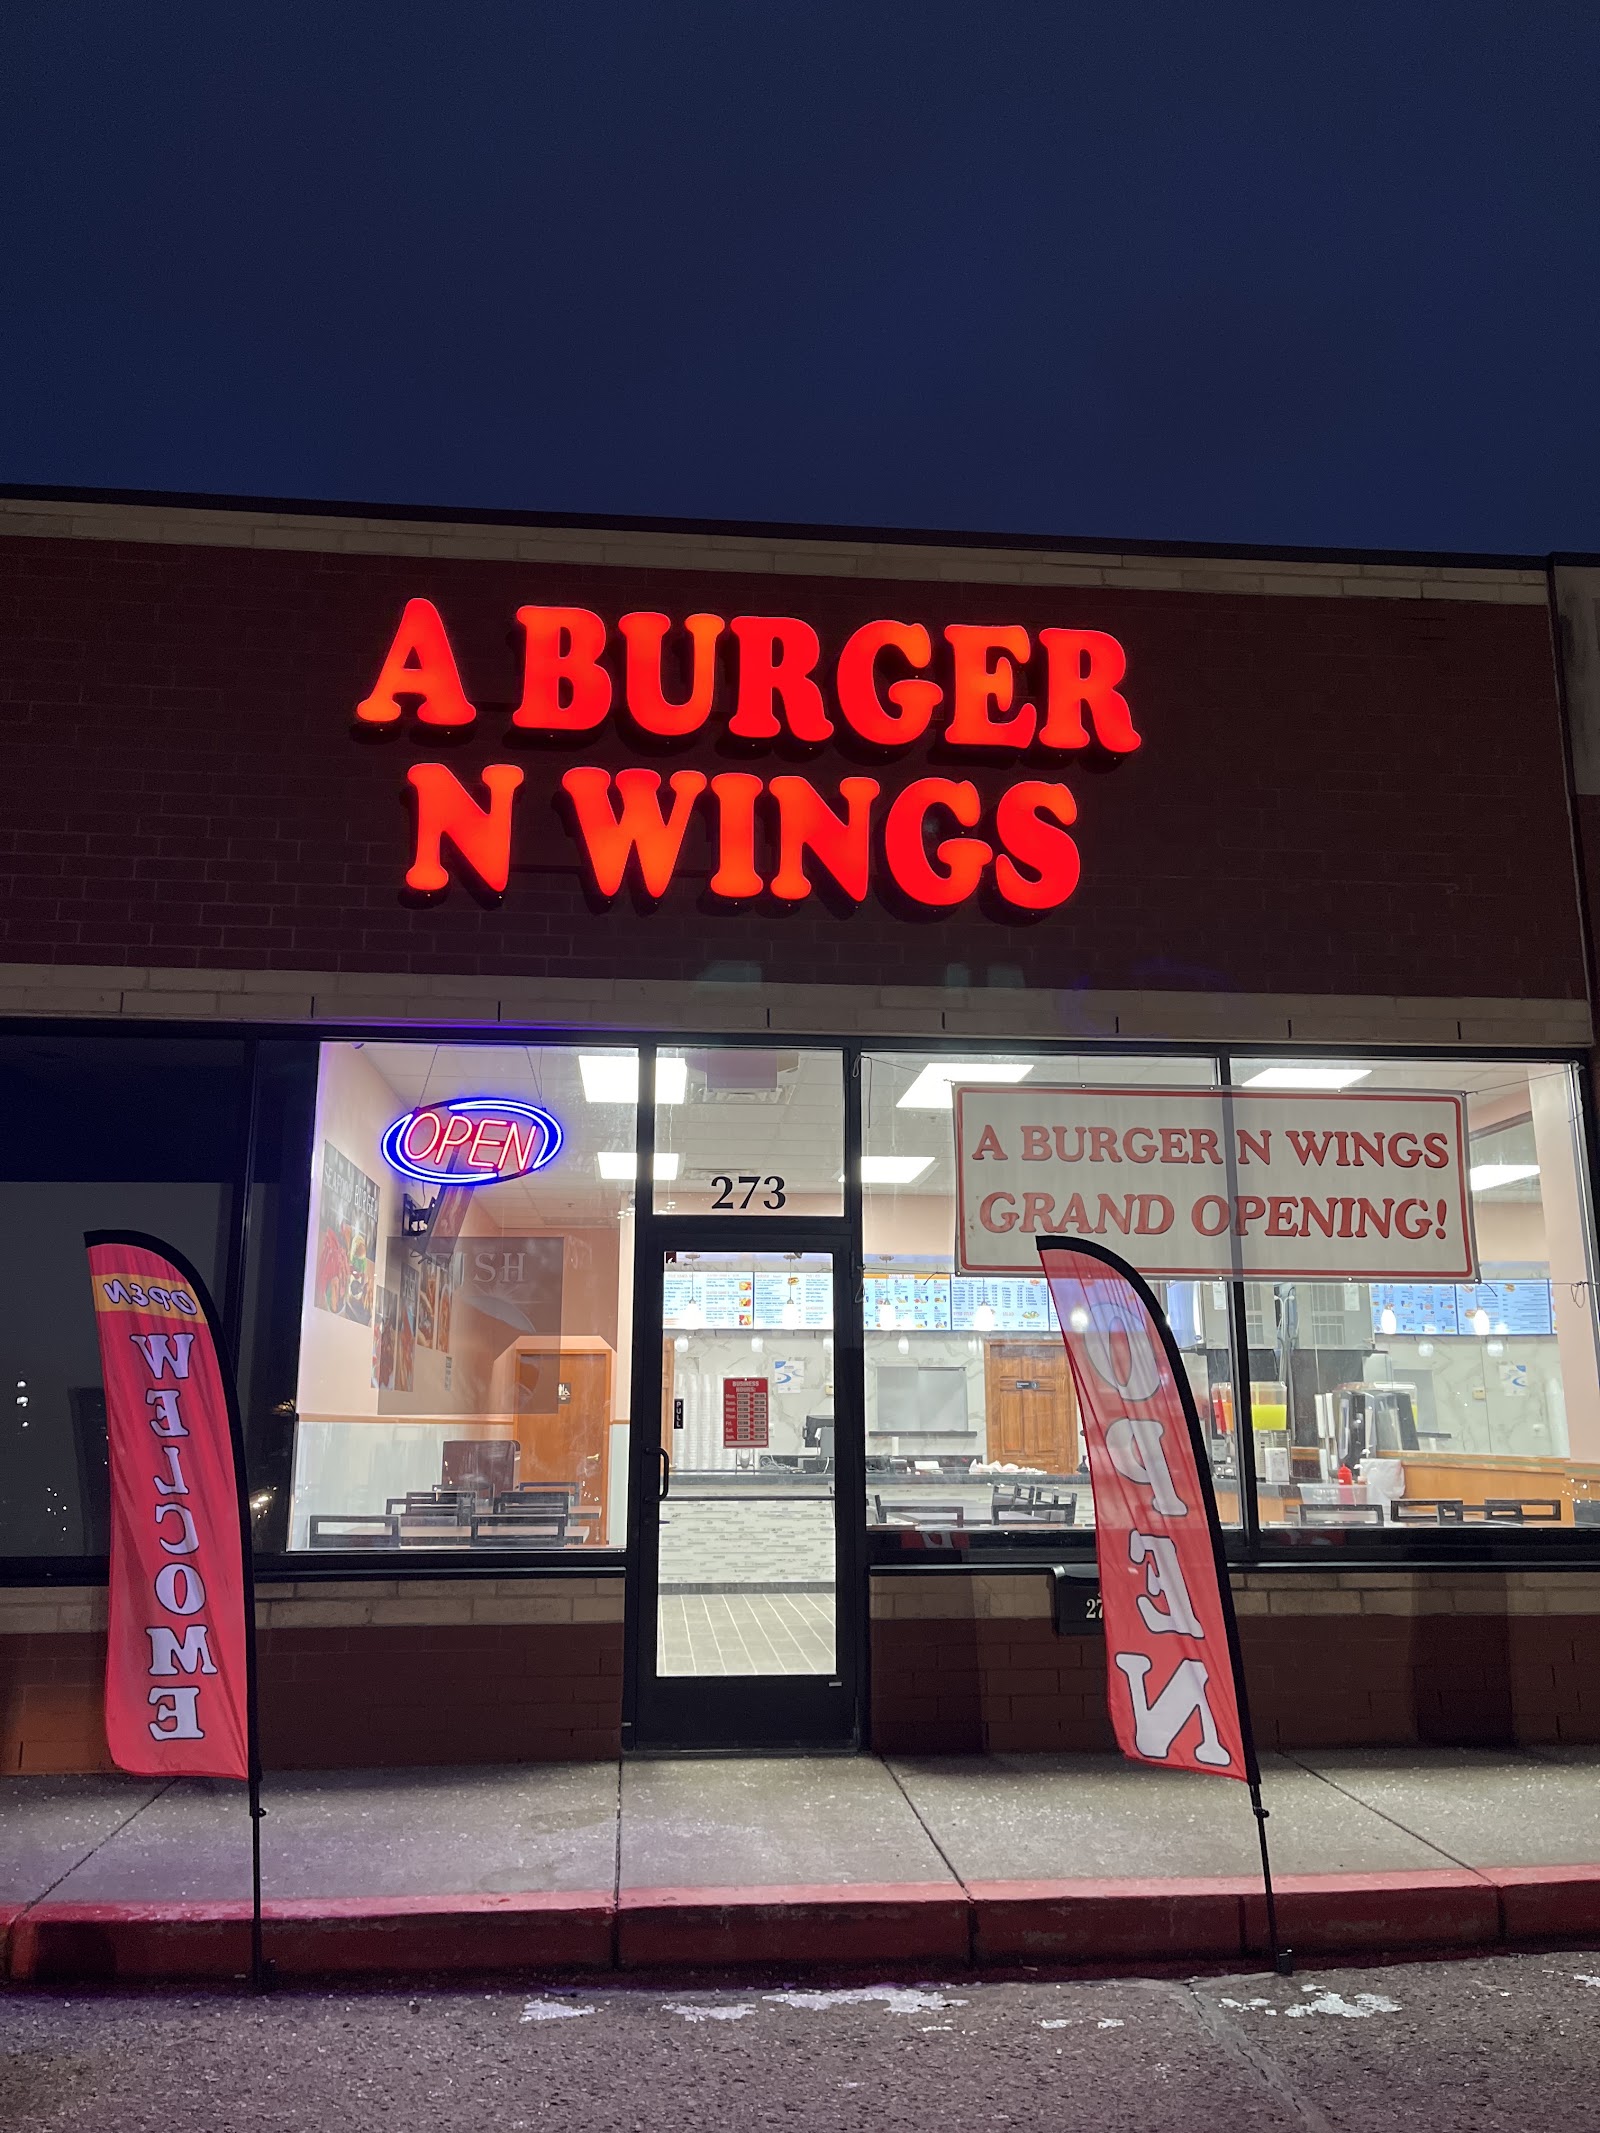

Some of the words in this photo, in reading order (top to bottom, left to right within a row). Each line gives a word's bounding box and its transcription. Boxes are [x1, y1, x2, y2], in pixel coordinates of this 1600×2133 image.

[356, 597, 476, 727] A
[512, 604, 1141, 753] BURGER
[406, 762, 524, 893] N
[562, 766, 1081, 910] WINGS
[403, 1111, 538, 1171] OPEN
[971, 1124, 1008, 1161] A
[1020, 1124, 1223, 1165] BURGER
[1235, 1129, 1272, 1165] N
[1286, 1130, 1450, 1169] WINGS
[711, 1175, 786, 1210] 273
[979, 1192, 1175, 1236] GRAND
[1191, 1194, 1448, 1240] OPENING!
[1086, 1598, 1103, 1619] 27
